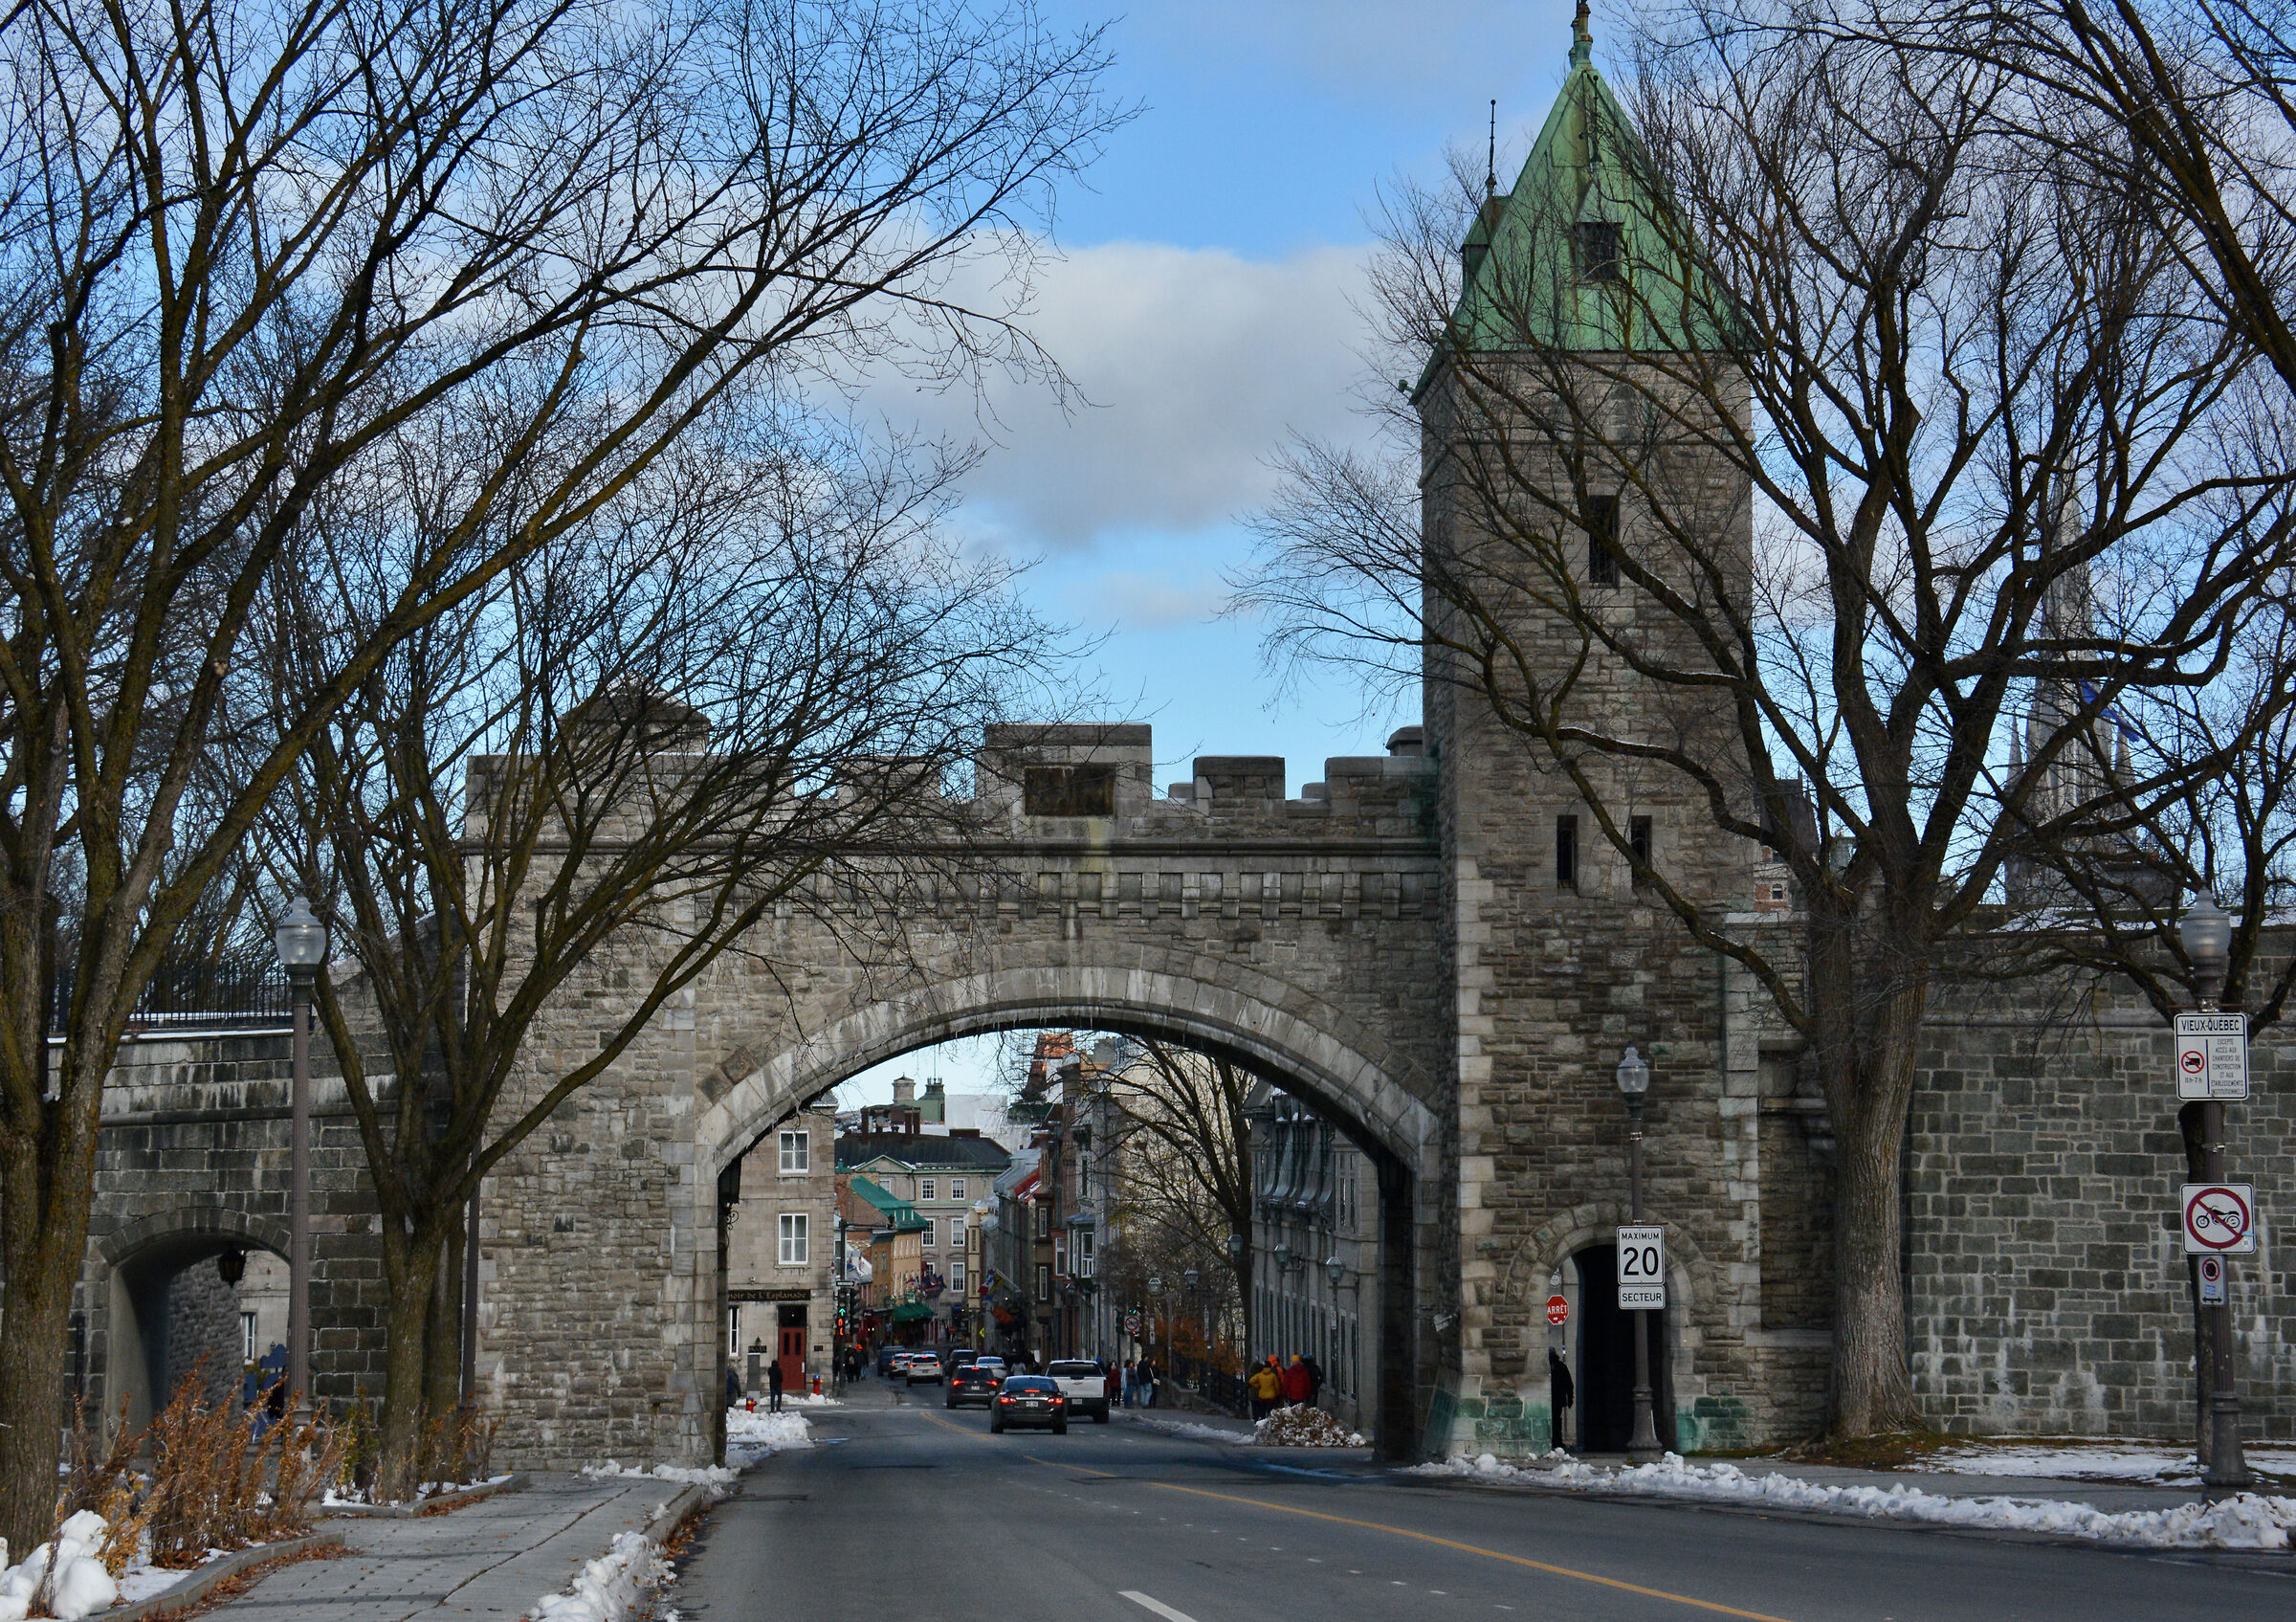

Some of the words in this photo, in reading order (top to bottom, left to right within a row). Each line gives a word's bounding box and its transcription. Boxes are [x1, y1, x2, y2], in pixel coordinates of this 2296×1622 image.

[2181, 1017, 2240, 1032] VIEUX-QUÉBEC
[1623, 1246, 1659, 1276] 20
[1622, 1292, 1663, 1302] SECTEUR
[1547, 1303, 1567, 1315] ARRÊT
